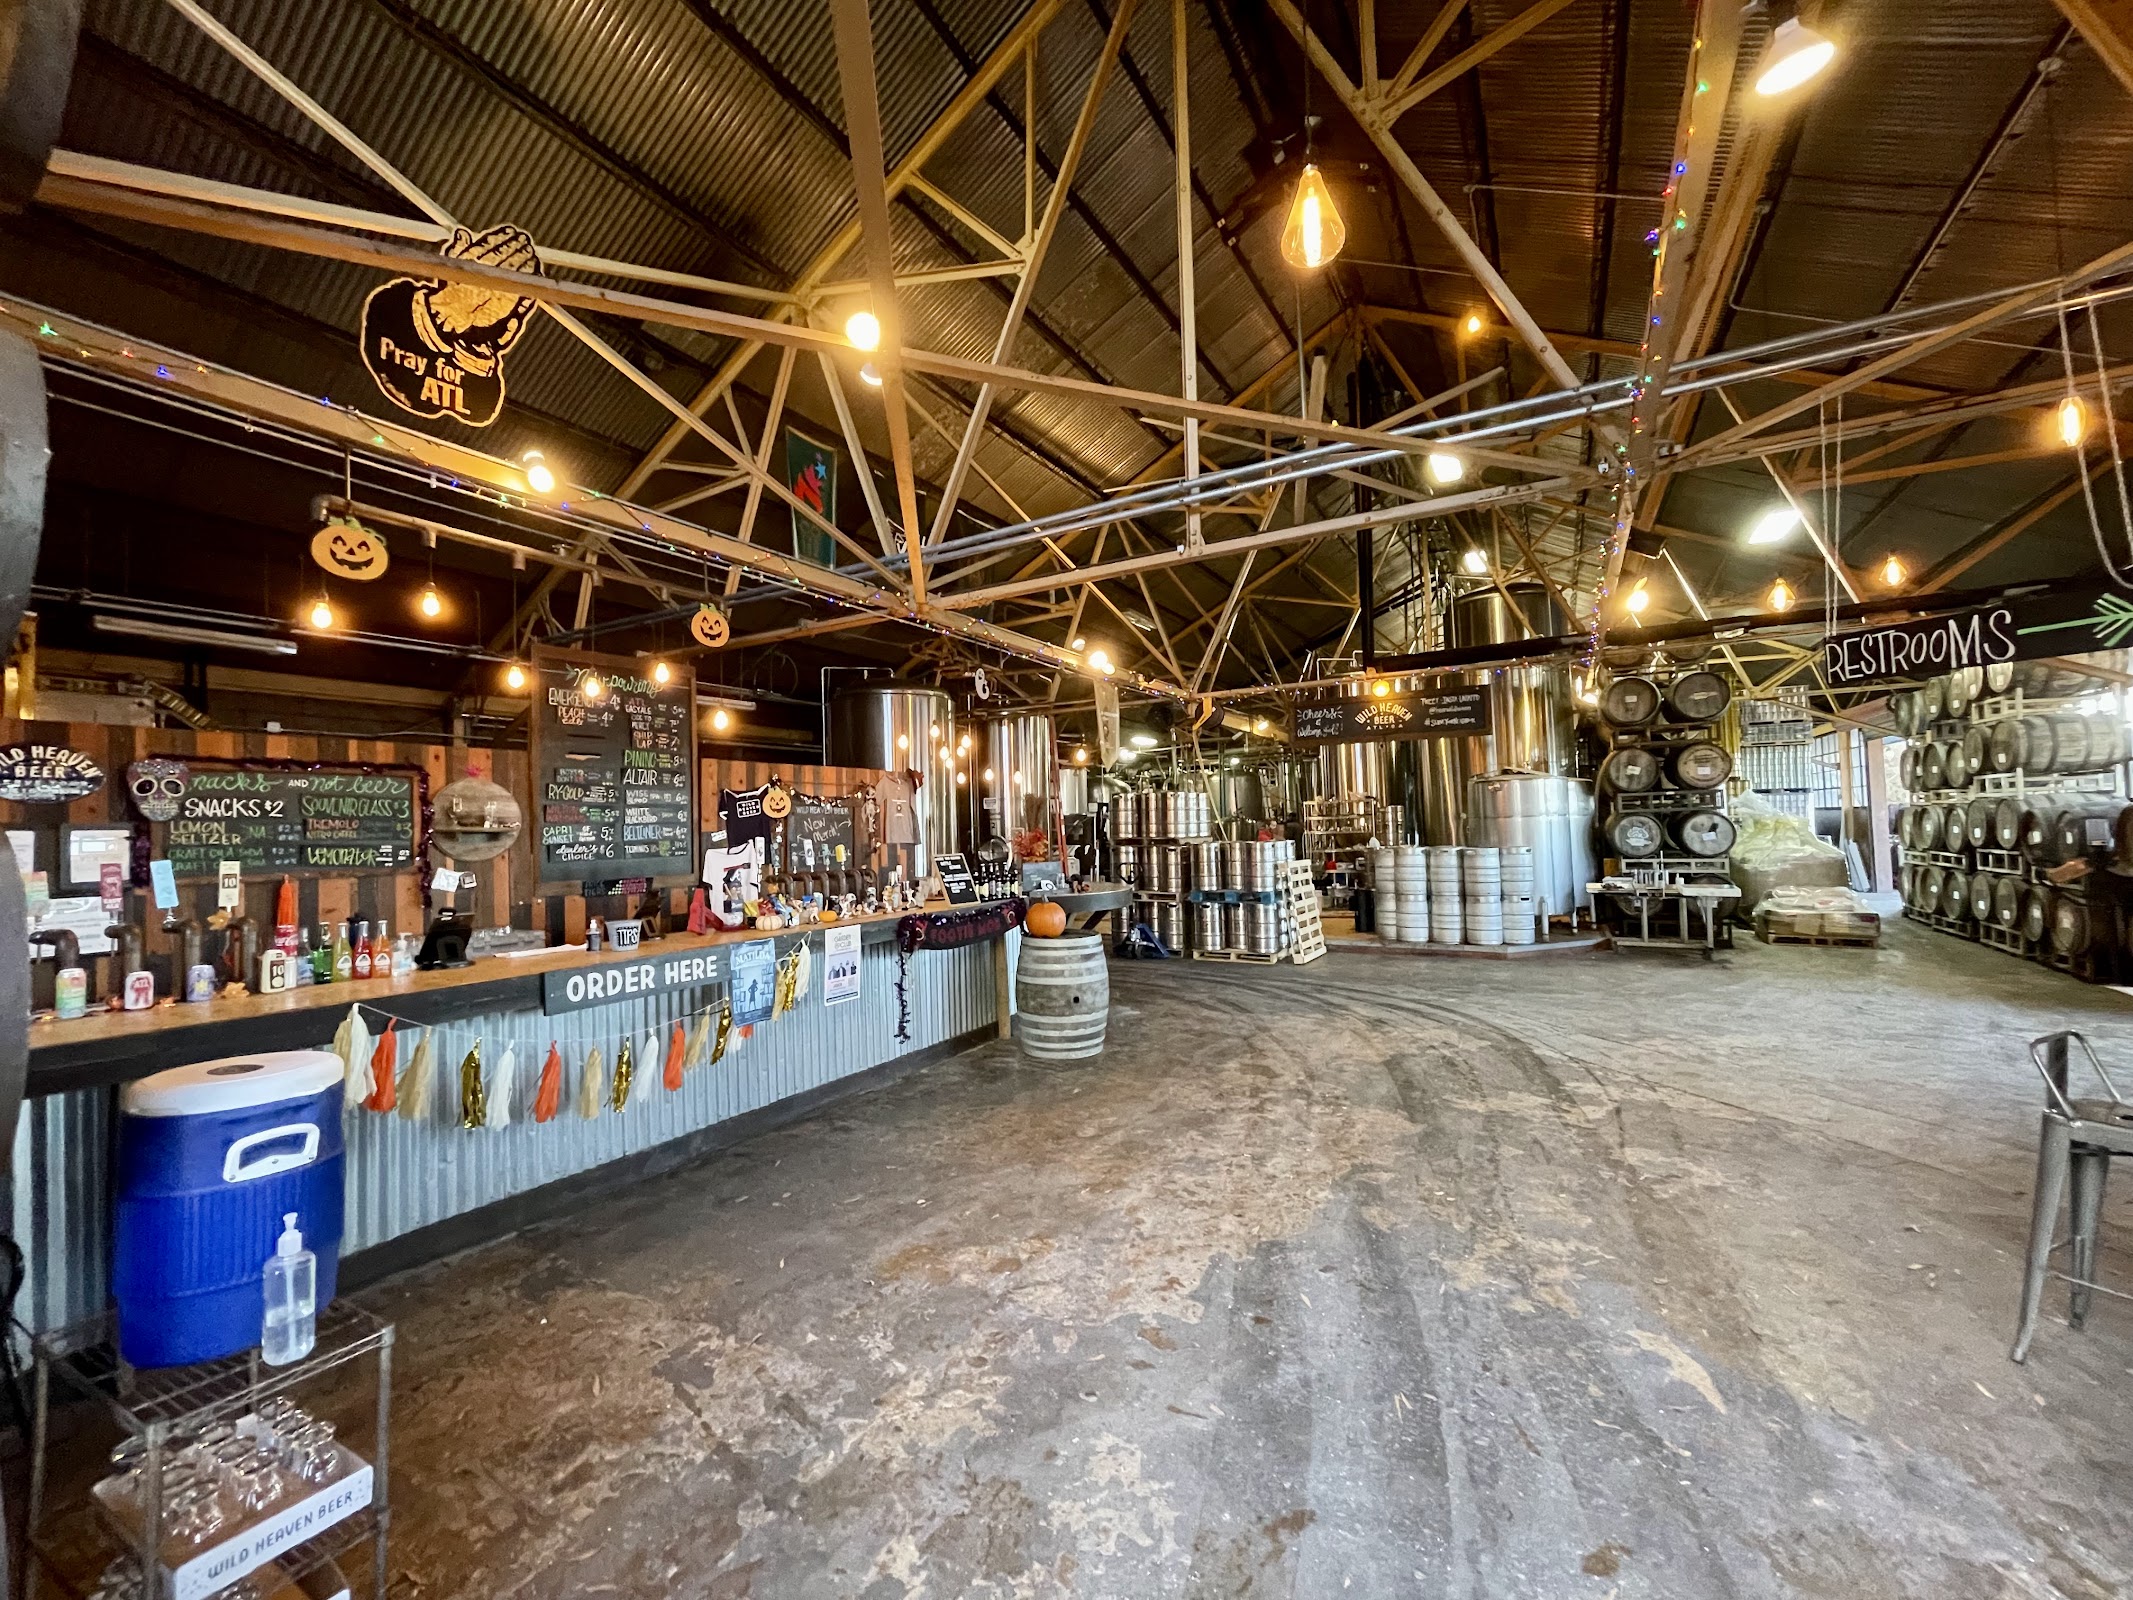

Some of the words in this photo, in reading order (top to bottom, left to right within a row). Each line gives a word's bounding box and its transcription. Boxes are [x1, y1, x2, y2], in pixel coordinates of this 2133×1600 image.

[379, 336, 428, 376] Pray
[435, 357, 465, 385] for
[420, 376, 471, 415] ATL
[1825, 609, 2016, 684] RESTROOMS
[1354, 705, 1377, 724] WILD
[1379, 702, 1413, 721] HEAVEN
[1374, 715, 1395, 724] BEER
[30, 745, 104, 778] HEAVEN
[14, 765, 66, 779] BEER
[623, 768, 658, 786] ALTAIR
[288, 779, 309, 788] AND
[346, 775, 409, 794] beer
[184, 797, 261, 818] SNACKS
[264, 799, 284, 818] $2
[359, 799, 392, 817] GLASS
[170, 820, 226, 834] LEMON
[308, 819, 360, 830] TREMOLO
[543, 825, 572, 837] CAPRI
[803, 817, 826, 833] New
[169, 833, 242, 845] SELTZER
[223, 877, 237, 888] 10
[617, 928, 638, 945] TIPS
[735, 948, 770, 965] MATILDA
[272, 964, 285, 977] 10
[565, 963, 656, 1003] ORDER
[664, 955, 718, 986] HERE
[207, 1548, 250, 1580] WILD
[255, 1511, 313, 1555] HEAVEN
[317, 1490, 353, 1520] BEER
